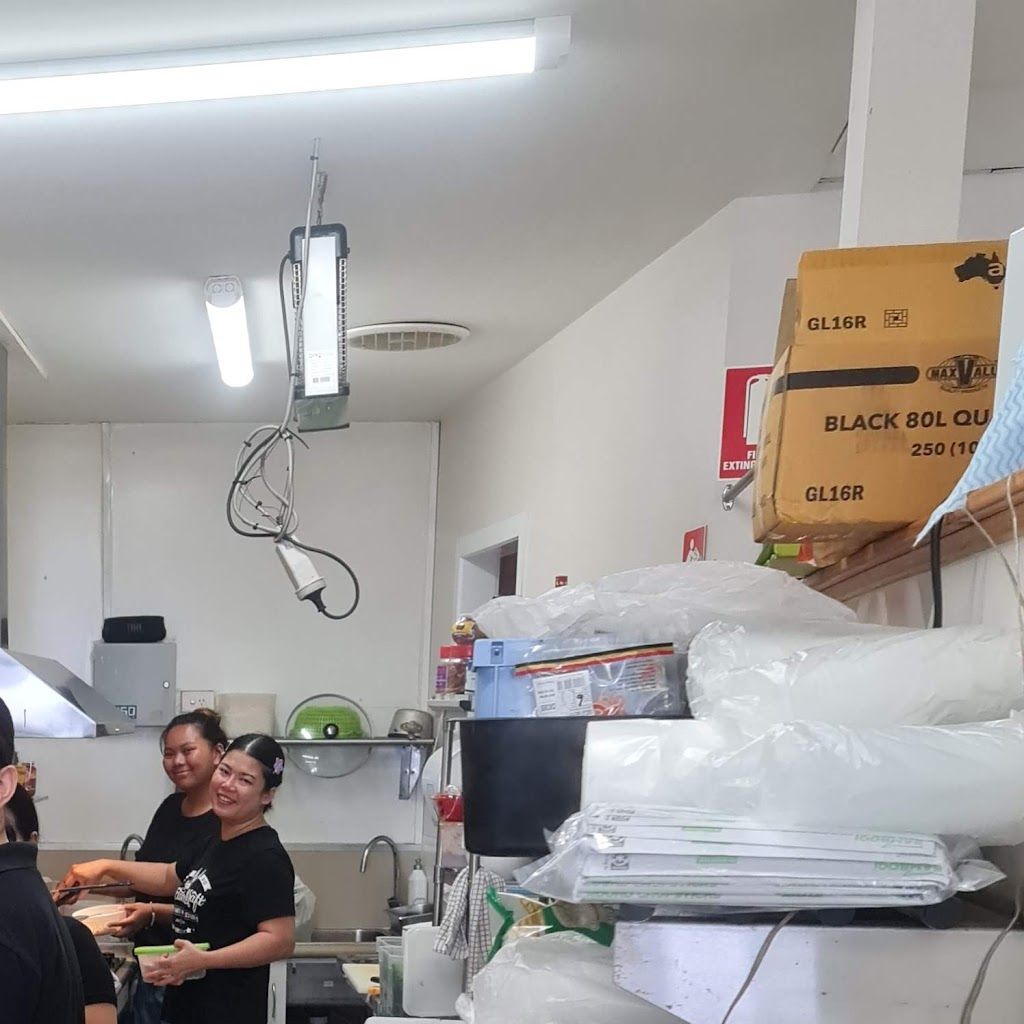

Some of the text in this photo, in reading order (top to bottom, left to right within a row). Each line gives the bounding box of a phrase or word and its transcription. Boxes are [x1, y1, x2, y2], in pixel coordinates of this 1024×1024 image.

[807, 315, 867, 331] GL16R
[824, 409, 990, 432] BLACK 80L QU
[747, 450, 756, 460] FI
[911, 441, 979, 457] 250 (10
[805, 485, 864, 502] GL16R
